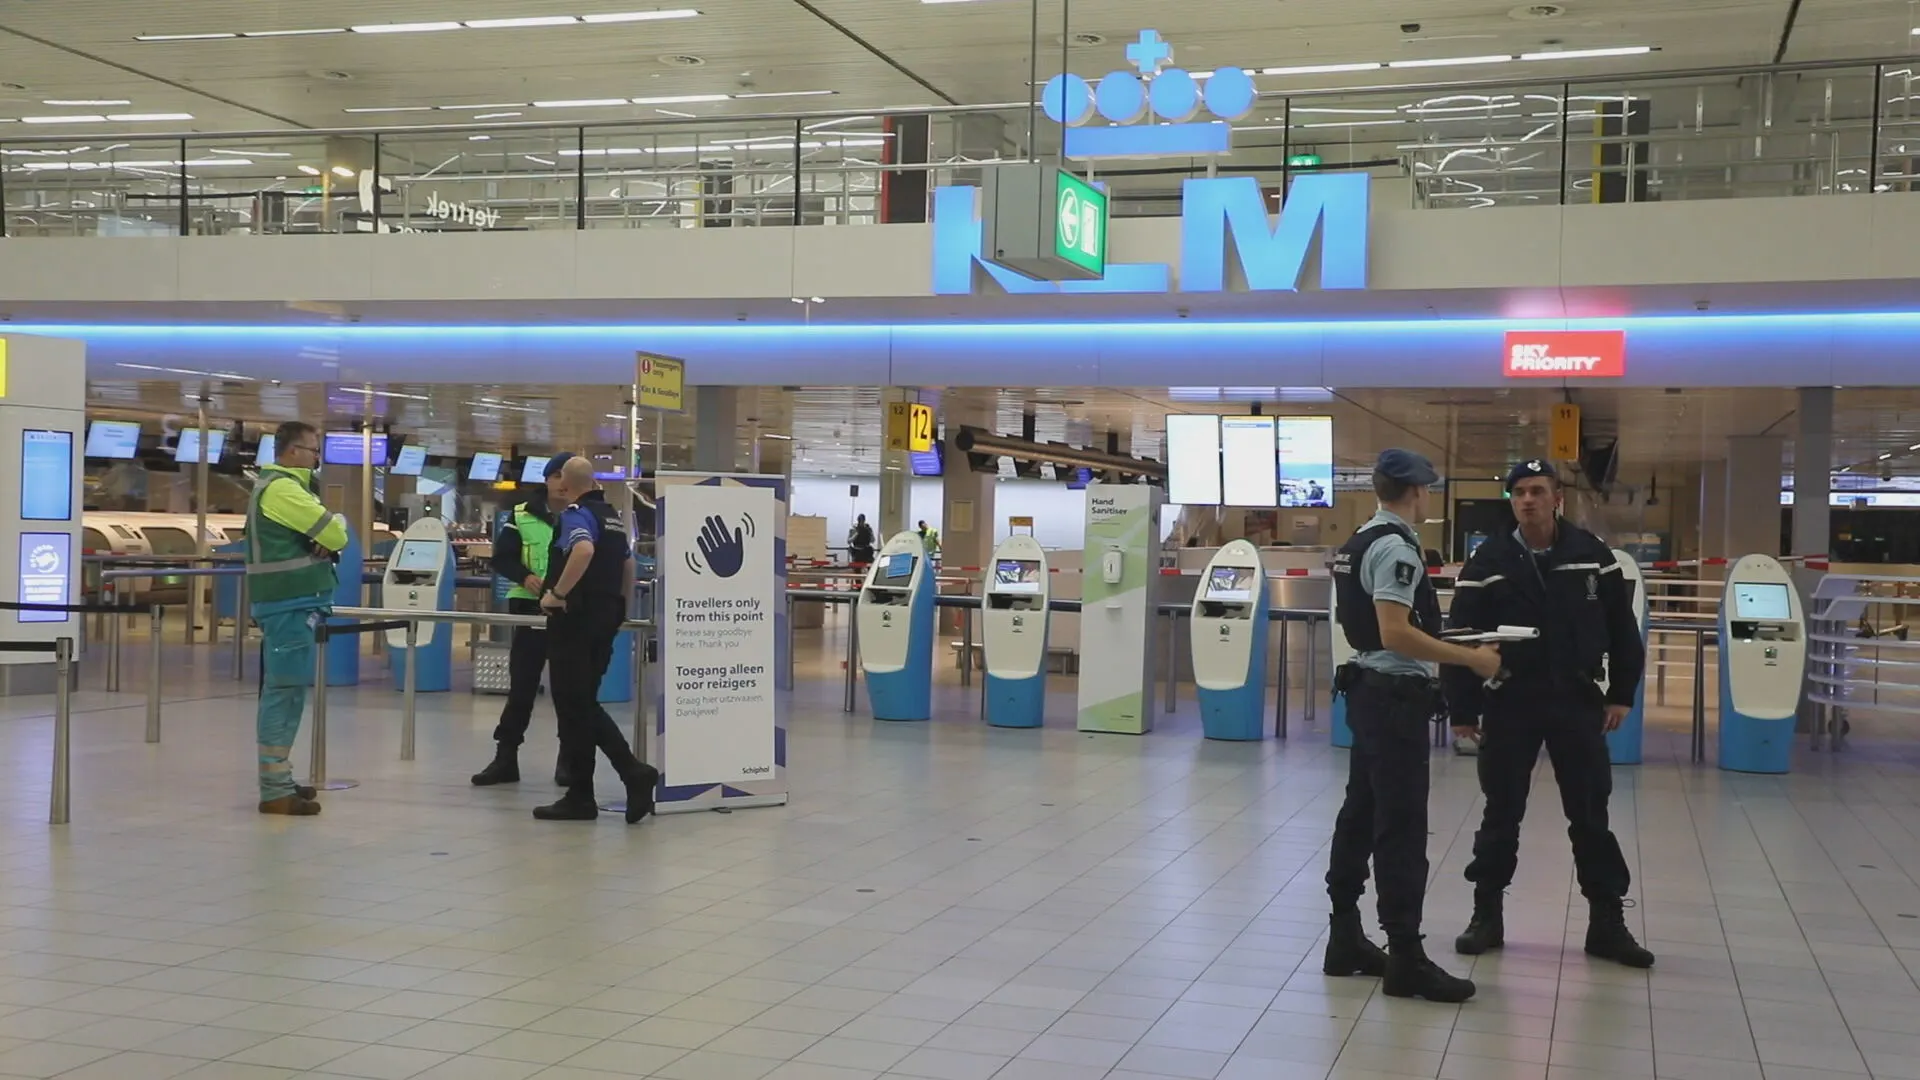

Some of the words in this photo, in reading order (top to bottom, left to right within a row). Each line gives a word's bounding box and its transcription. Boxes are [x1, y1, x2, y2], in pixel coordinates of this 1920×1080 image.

[1511, 344, 1549, 357] SKY
[1560, 409, 1571, 419] 11
[913, 408, 927, 440] 12
[1091, 506, 1128, 515] Sanitiser
[676, 597, 733, 608] Travellers
[735, 597, 760, 610] only
[676, 611, 706, 622] from
[708, 611, 730, 621] this
[733, 611, 764, 624] point
[676, 628, 701, 637] Please
[702, 630, 716, 638] say
[717, 627, 752, 638] goodbye
[698, 640, 722, 649] Thank
[724, 641, 740, 651] you
[676, 666, 727, 678] Toegang
[729, 664, 764, 674] alleen
[676, 682, 705, 690] voor
[707, 678, 757, 691] reizigers
[676, 696, 701, 706] Graag
[742, 766, 770, 775] Schiphol
